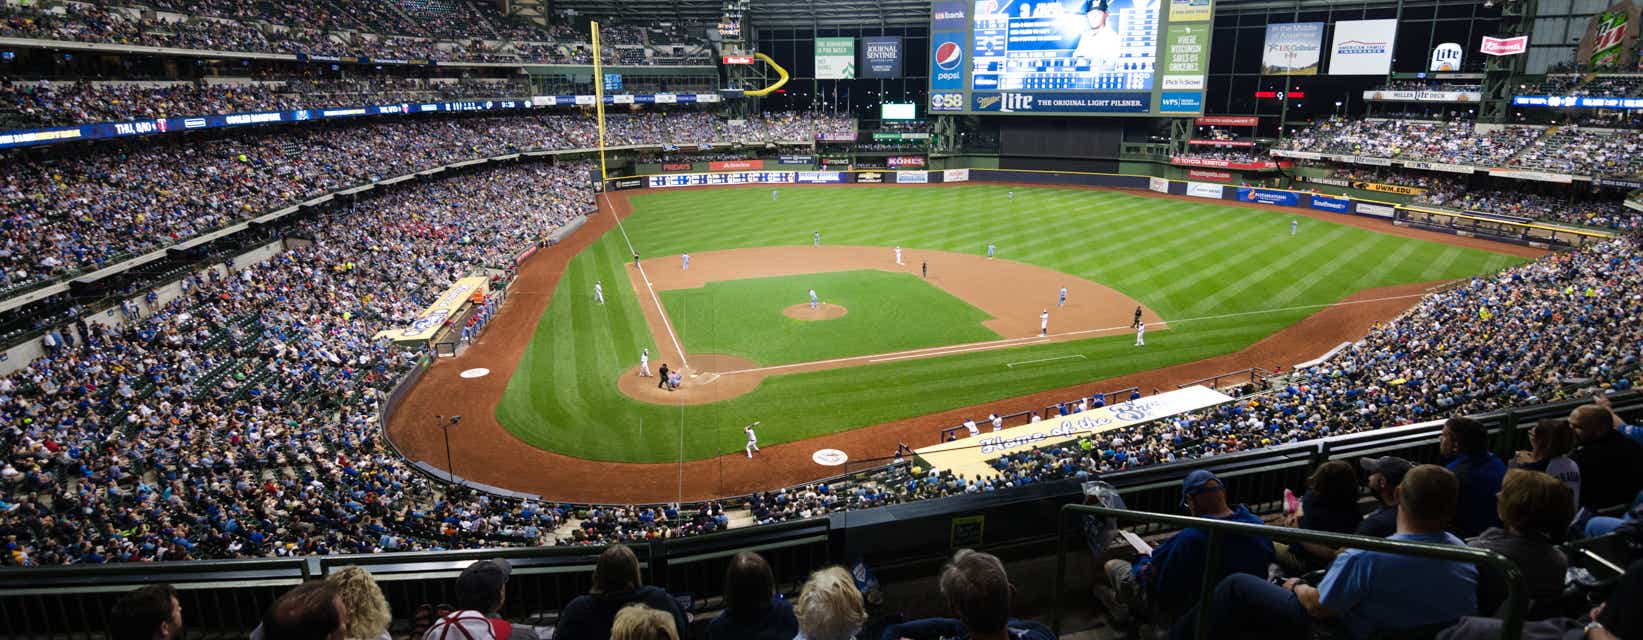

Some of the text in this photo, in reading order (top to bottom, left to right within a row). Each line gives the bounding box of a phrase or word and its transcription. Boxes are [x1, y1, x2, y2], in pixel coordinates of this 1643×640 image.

[866, 51, 897, 59] SENTINEL
[1436, 48, 1459, 61] Lite
[937, 71, 961, 80] pepsi
[943, 94, 963, 107] 58
[1000, 92, 1033, 112] Lite
[1181, 158, 1201, 166] TOYOTA
[1375, 184, 1411, 194] UWM.EDU
[979, 431, 1048, 454] Home
[1050, 419, 1077, 437] of
[1078, 415, 1112, 430] the
